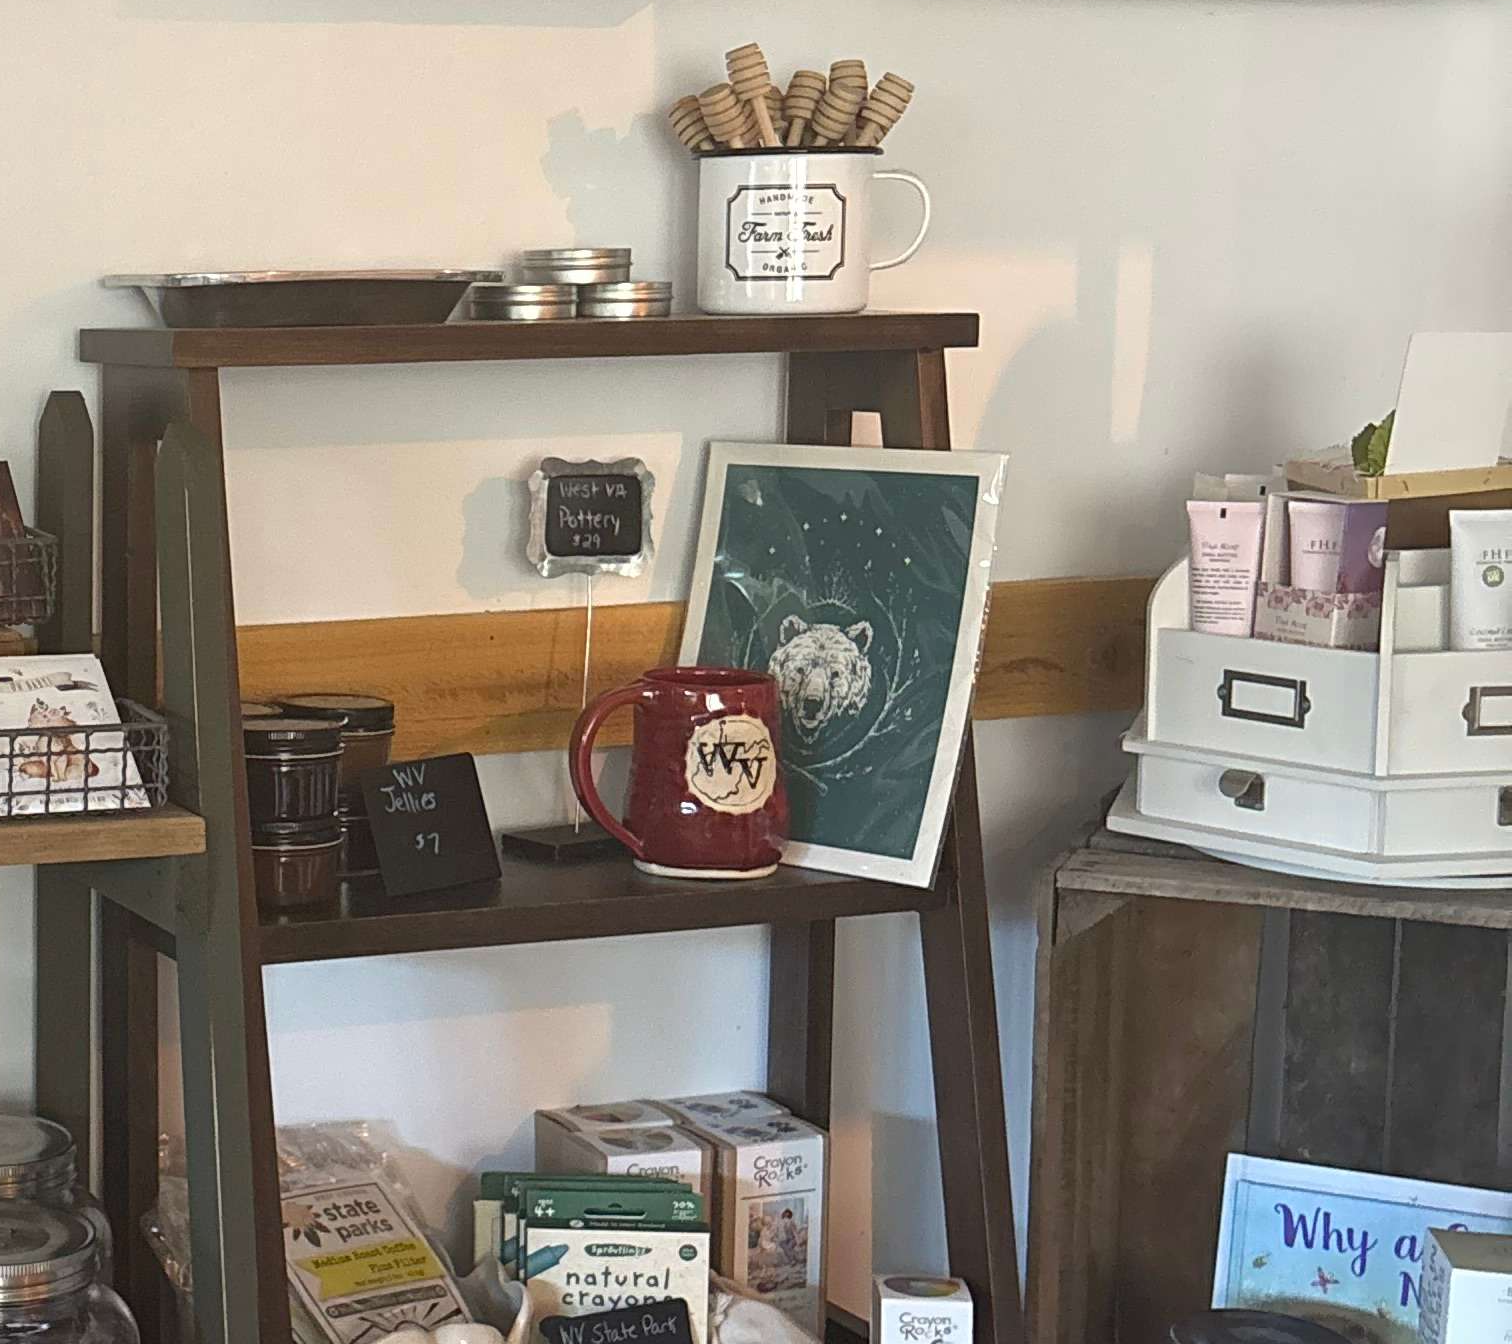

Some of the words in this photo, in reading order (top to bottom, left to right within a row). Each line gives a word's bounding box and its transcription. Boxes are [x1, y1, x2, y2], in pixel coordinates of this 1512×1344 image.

[738, 221, 783, 243] Farm
[559, 480, 599, 498] West
[605, 481, 627, 499] VA
[559, 505, 620, 536] Pottery
[392, 763, 426, 788] WV
[697, 741, 767, 790] WV
[380, 786, 436, 813] Jellies
[415, 832, 439, 854] $7
[753, 1154, 803, 1172] Crayon
[753, 1167, 803, 1189] Rocks
[322, 1199, 381, 1221] state
[534, 1207, 556, 1218] 4+
[335, 1218, 394, 1243] parks
[1274, 1202, 1379, 1277] Why
[1394, 1234, 1424, 1263] a
[566, 1266, 670, 1291] natural
[591, 1320, 638, 1344] State
[642, 1313, 677, 1336] Park
[899, 1311, 953, 1329] Crayon
[899, 1324, 952, 1342] Rocks
